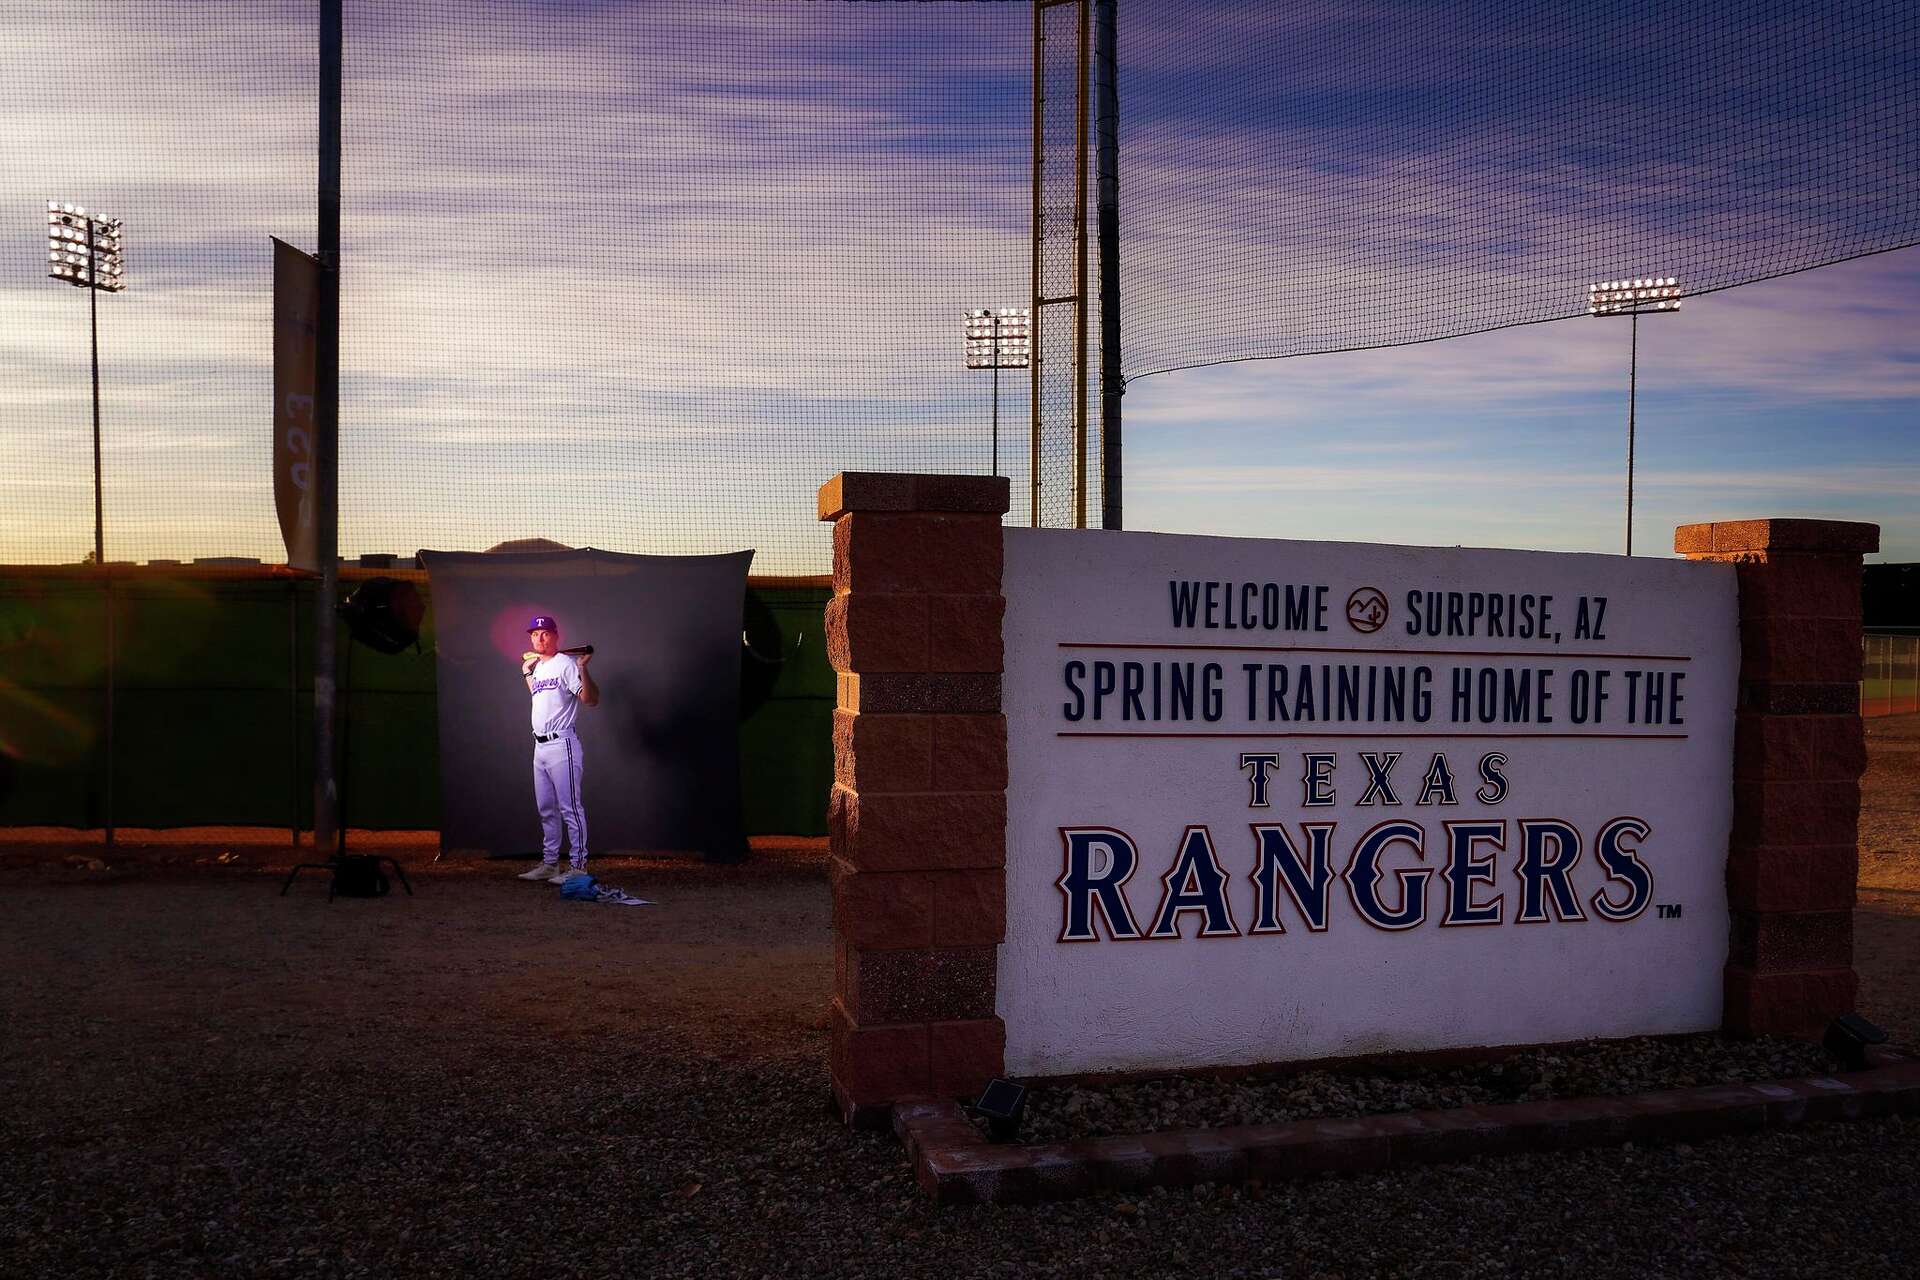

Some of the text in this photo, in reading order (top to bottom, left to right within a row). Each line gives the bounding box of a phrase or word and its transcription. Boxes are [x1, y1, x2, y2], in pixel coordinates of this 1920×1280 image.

[536, 618, 545, 627] T
[1169, 581, 1608, 645] WELCOME SURPRISE, AZ
[1063, 660, 1686, 725] SPRING TRAINING HOME OF THE
[1240, 751, 1510, 808] TEXAS
[1055, 817, 1682, 944] RANGERS TM
